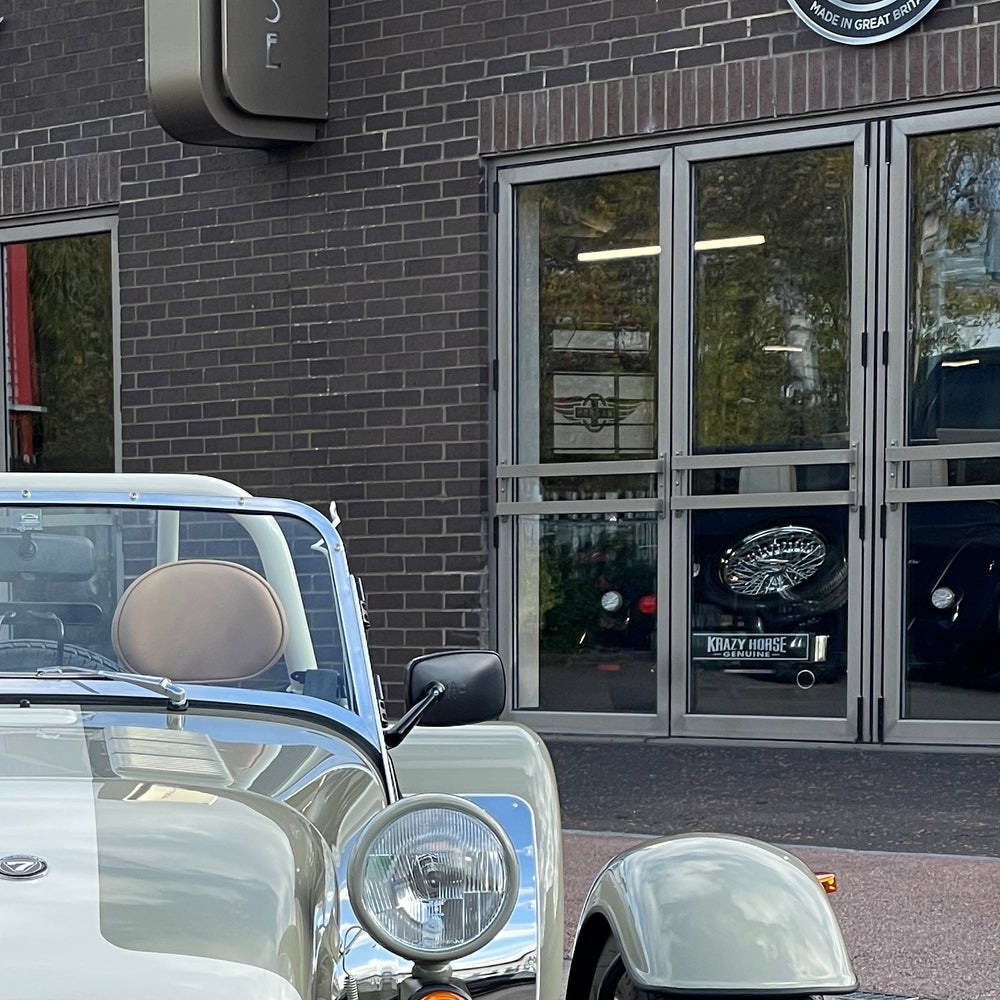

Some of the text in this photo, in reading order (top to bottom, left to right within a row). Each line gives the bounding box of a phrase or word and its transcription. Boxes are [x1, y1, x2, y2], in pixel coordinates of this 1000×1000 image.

[810, 1, 840, 26] MADE
[840, 17, 853, 30] IN
[854, 12, 891, 31] GREAT
[707, 636, 787, 653] KRAZY HORSE
[723, 650, 771, 658] GENUINE
